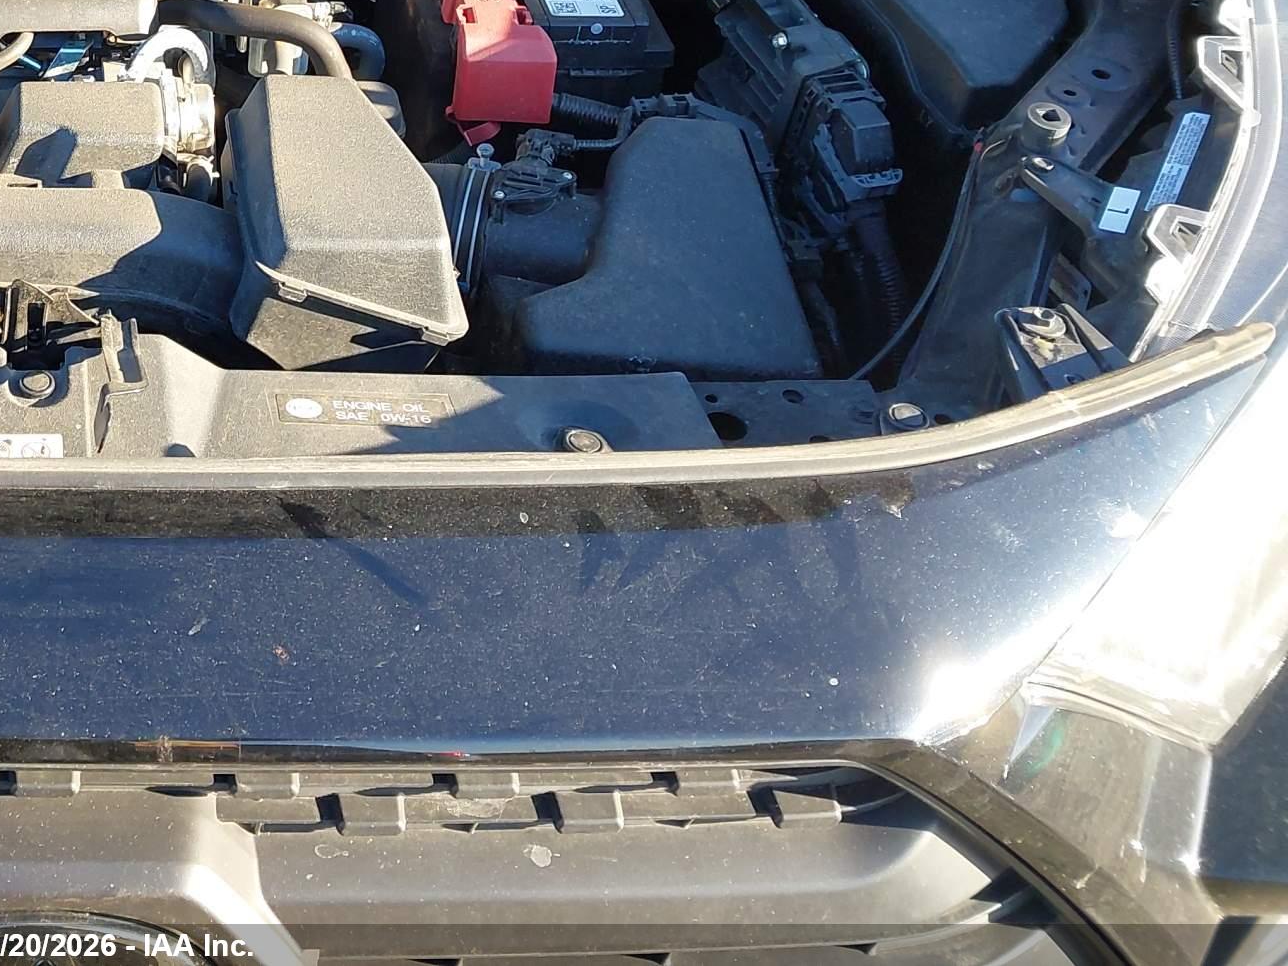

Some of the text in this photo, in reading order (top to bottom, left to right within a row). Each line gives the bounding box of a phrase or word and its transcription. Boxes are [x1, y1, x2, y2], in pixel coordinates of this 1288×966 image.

[332, 399, 393, 412] ENGINE
[401, 401, 431, 414] OIL
[335, 410, 432, 425] SAE 0W-16
